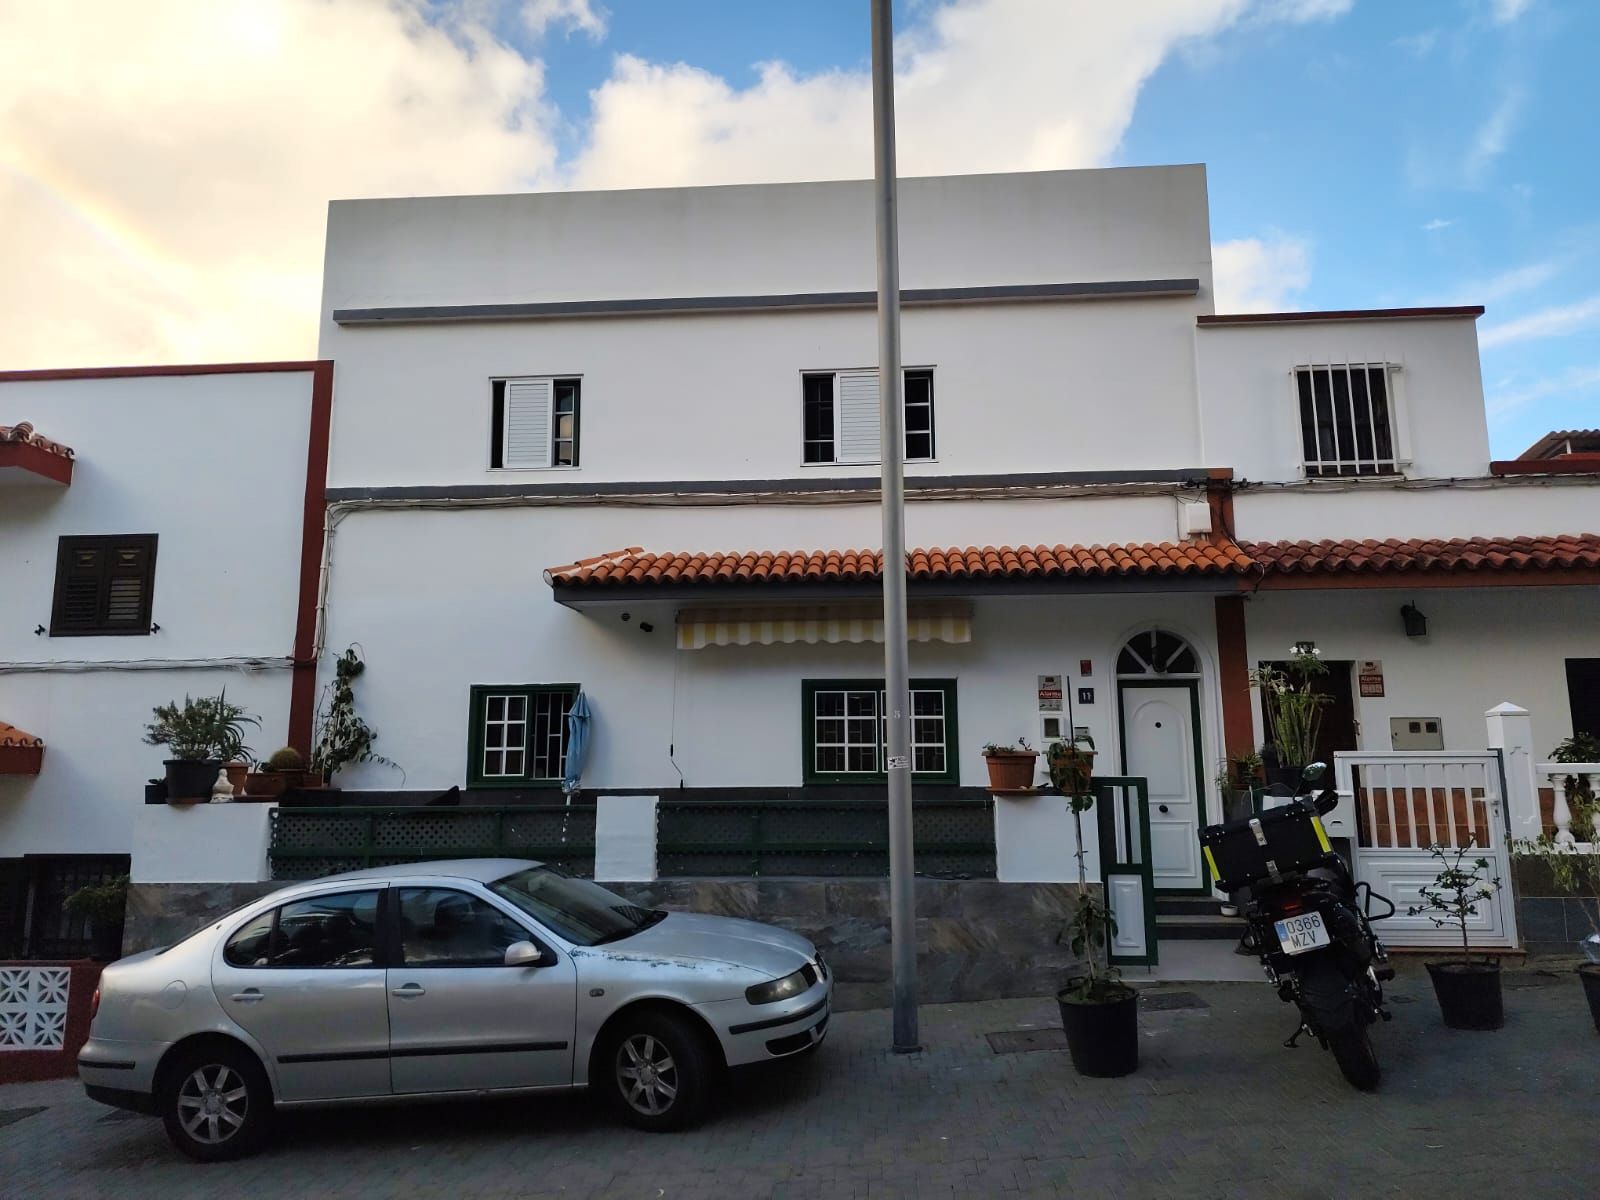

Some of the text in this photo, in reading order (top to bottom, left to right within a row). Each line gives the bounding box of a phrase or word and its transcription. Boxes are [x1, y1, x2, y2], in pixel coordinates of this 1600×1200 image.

[1082, 692, 1091, 701] 11
[1286, 915, 1321, 934] 0366
[1290, 930, 1316, 949] MZV
